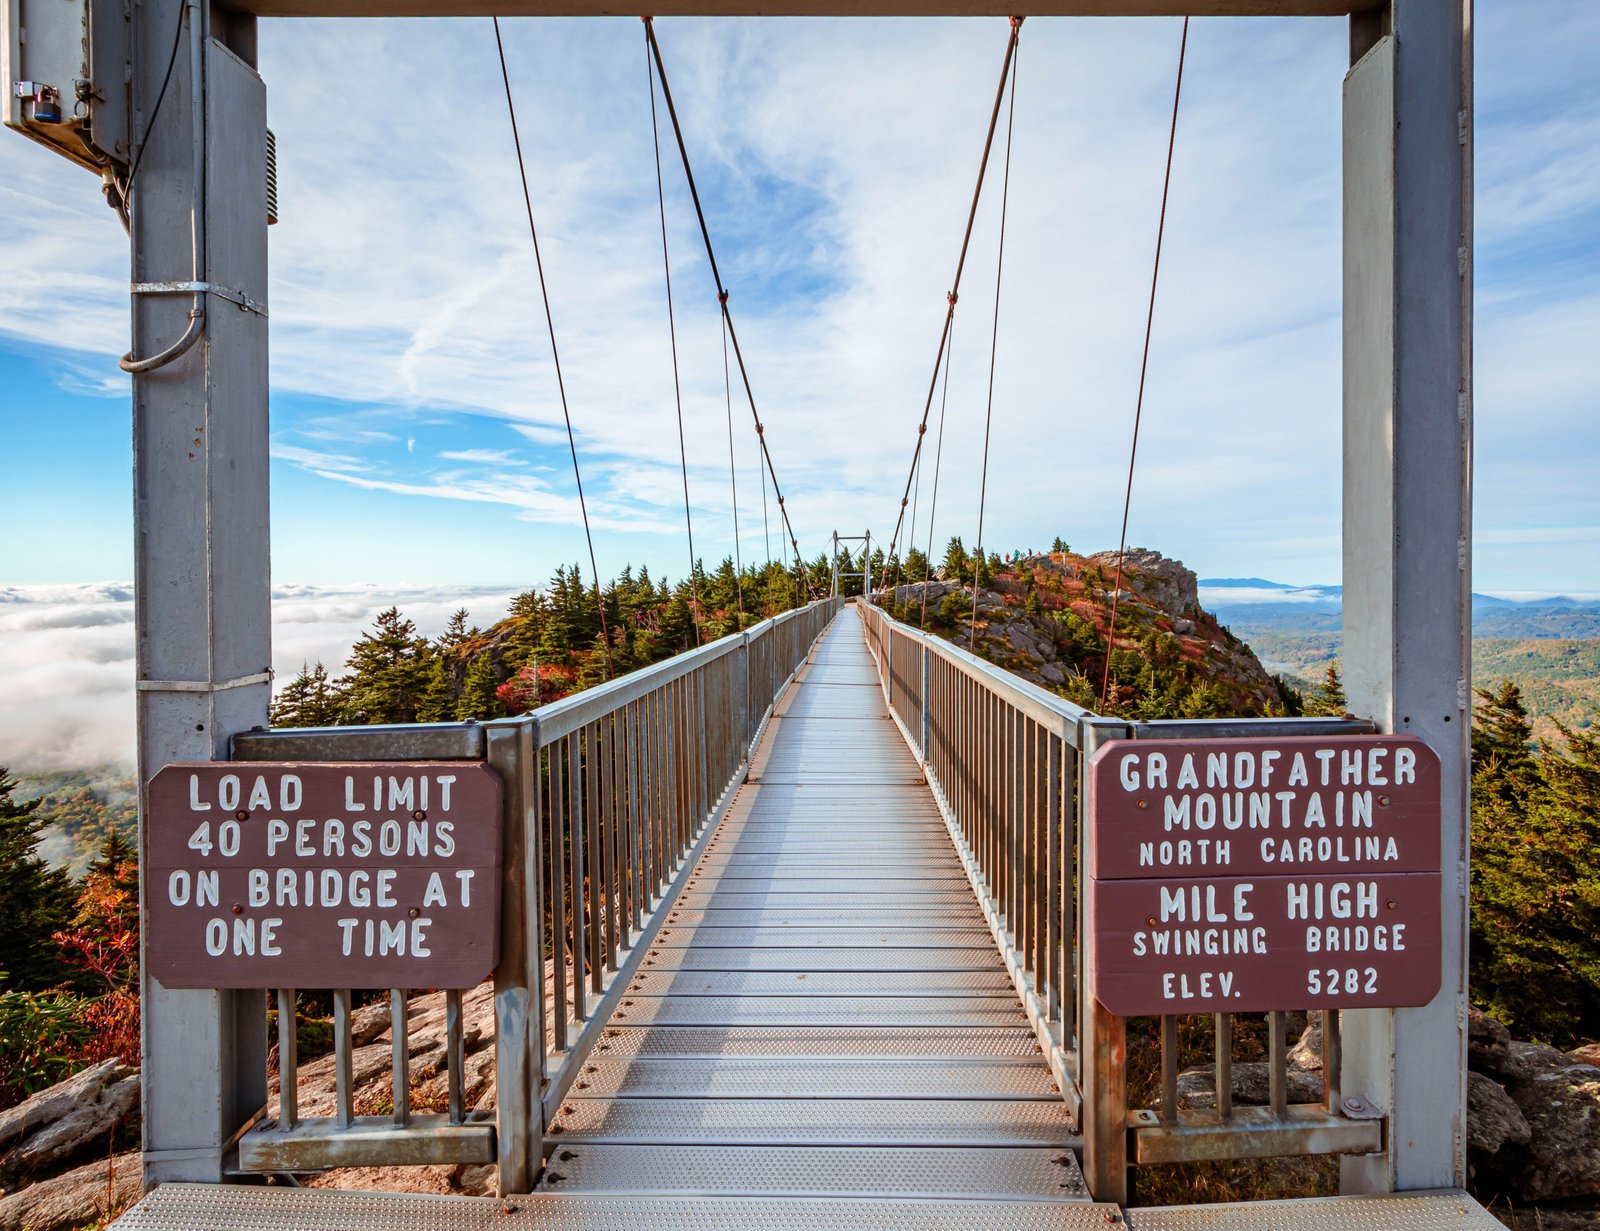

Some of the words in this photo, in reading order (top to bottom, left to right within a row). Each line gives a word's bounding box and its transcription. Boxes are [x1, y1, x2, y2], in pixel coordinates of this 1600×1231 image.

[1119, 747, 1417, 792] GRANDFATHER
[190, 774, 303, 811] LOAD
[345, 775, 457, 811] LIMIT
[1163, 790, 1373, 832] MOUNTAIN
[188, 820, 241, 857] 40
[267, 818, 456, 858] PERSONS
[1139, 839, 1230, 866] NORTH
[1260, 836, 1399, 863] CAROLINA
[168, 869, 219, 907] ON
[248, 867, 398, 908] BRIDGE
[423, 869, 475, 908] AT
[1160, 883, 1255, 923] MILE
[1286, 881, 1378, 920] HIGH
[205, 917, 283, 957] ONE
[337, 918, 433, 958] TIME
[1132, 926, 1267, 956] SWINGING
[1306, 923, 1406, 953] BRIDGE
[1162, 971, 1241, 999] ELEV.
[1307, 967, 1378, 995] 5282
